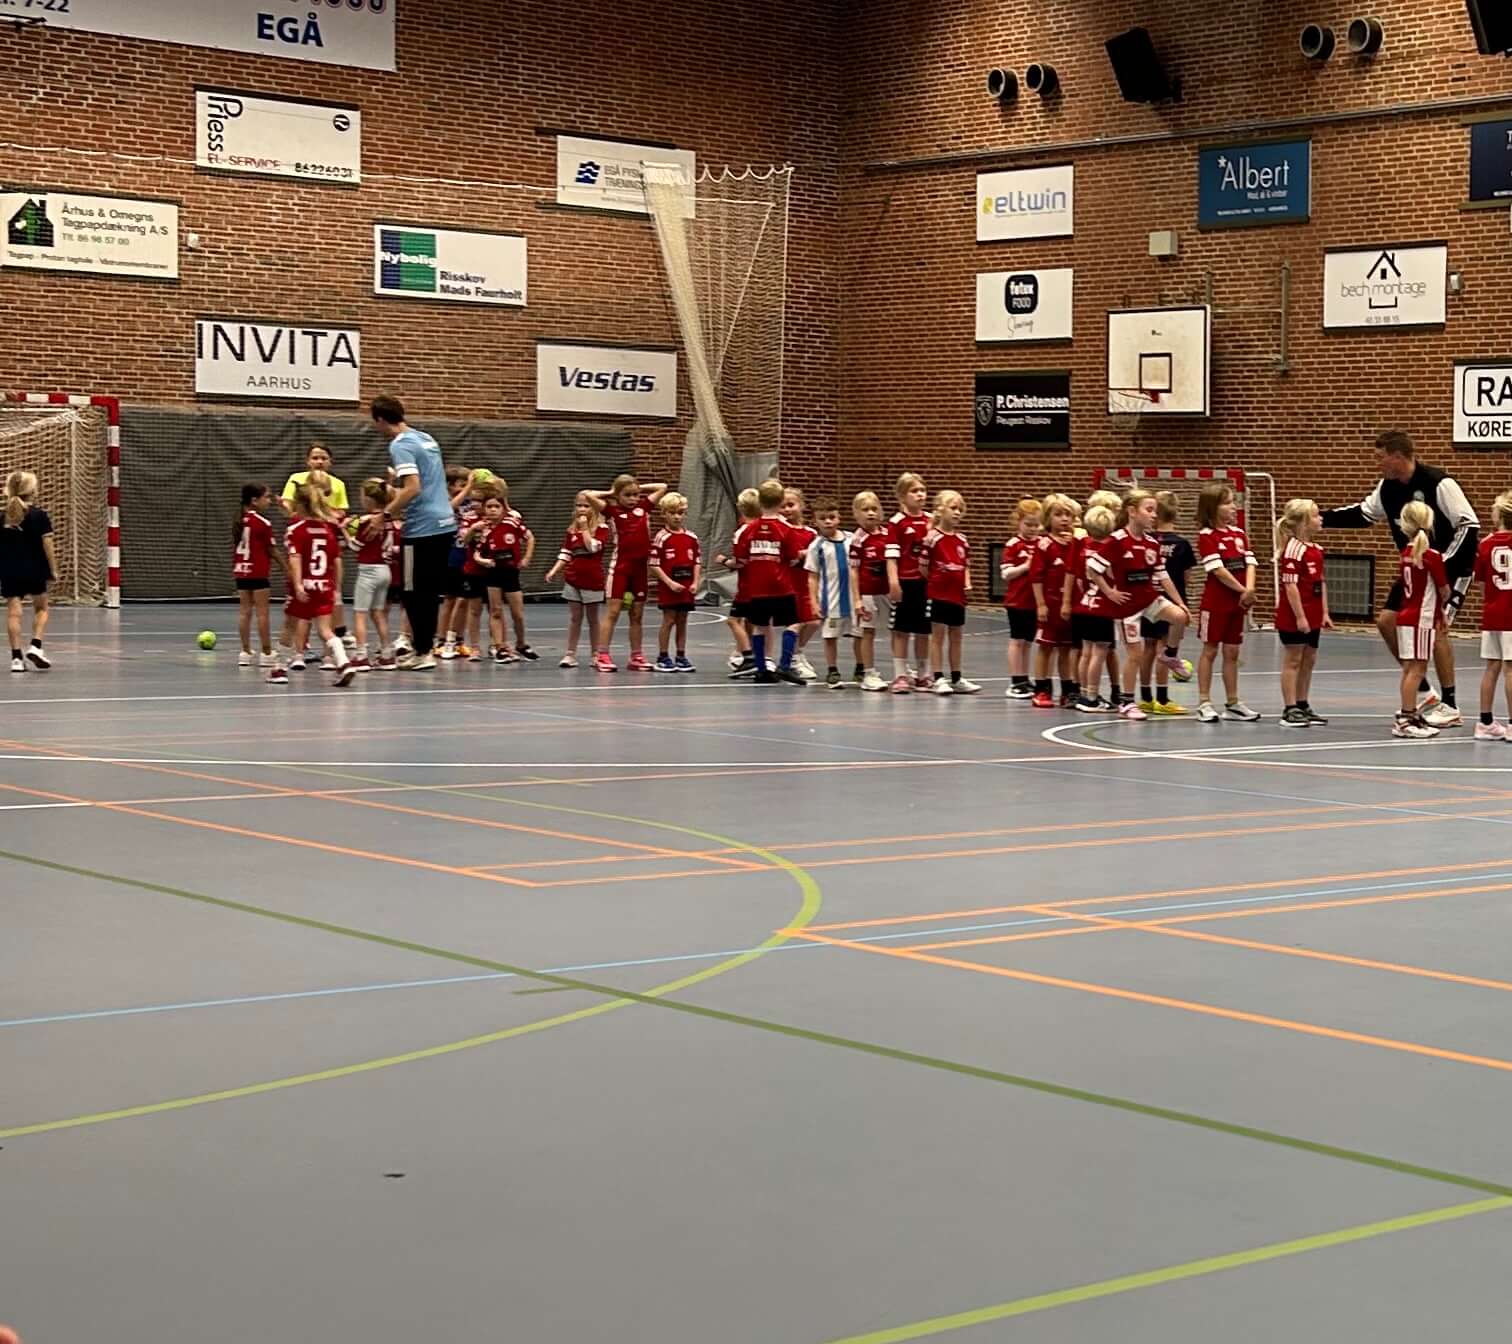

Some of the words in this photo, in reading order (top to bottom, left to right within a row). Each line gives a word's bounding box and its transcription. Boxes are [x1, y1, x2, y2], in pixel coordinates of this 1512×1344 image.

[257, 12, 324, 47] EGÅ
[995, 188, 1066, 213] eltwin
[1371, 281, 1427, 298] montage
[197, 323, 358, 368] INVITA
[246, 375, 312, 391] AARHUS
[559, 366, 657, 393] Vestas
[236, 526, 250, 561] 4
[309, 538, 328, 577] 5
